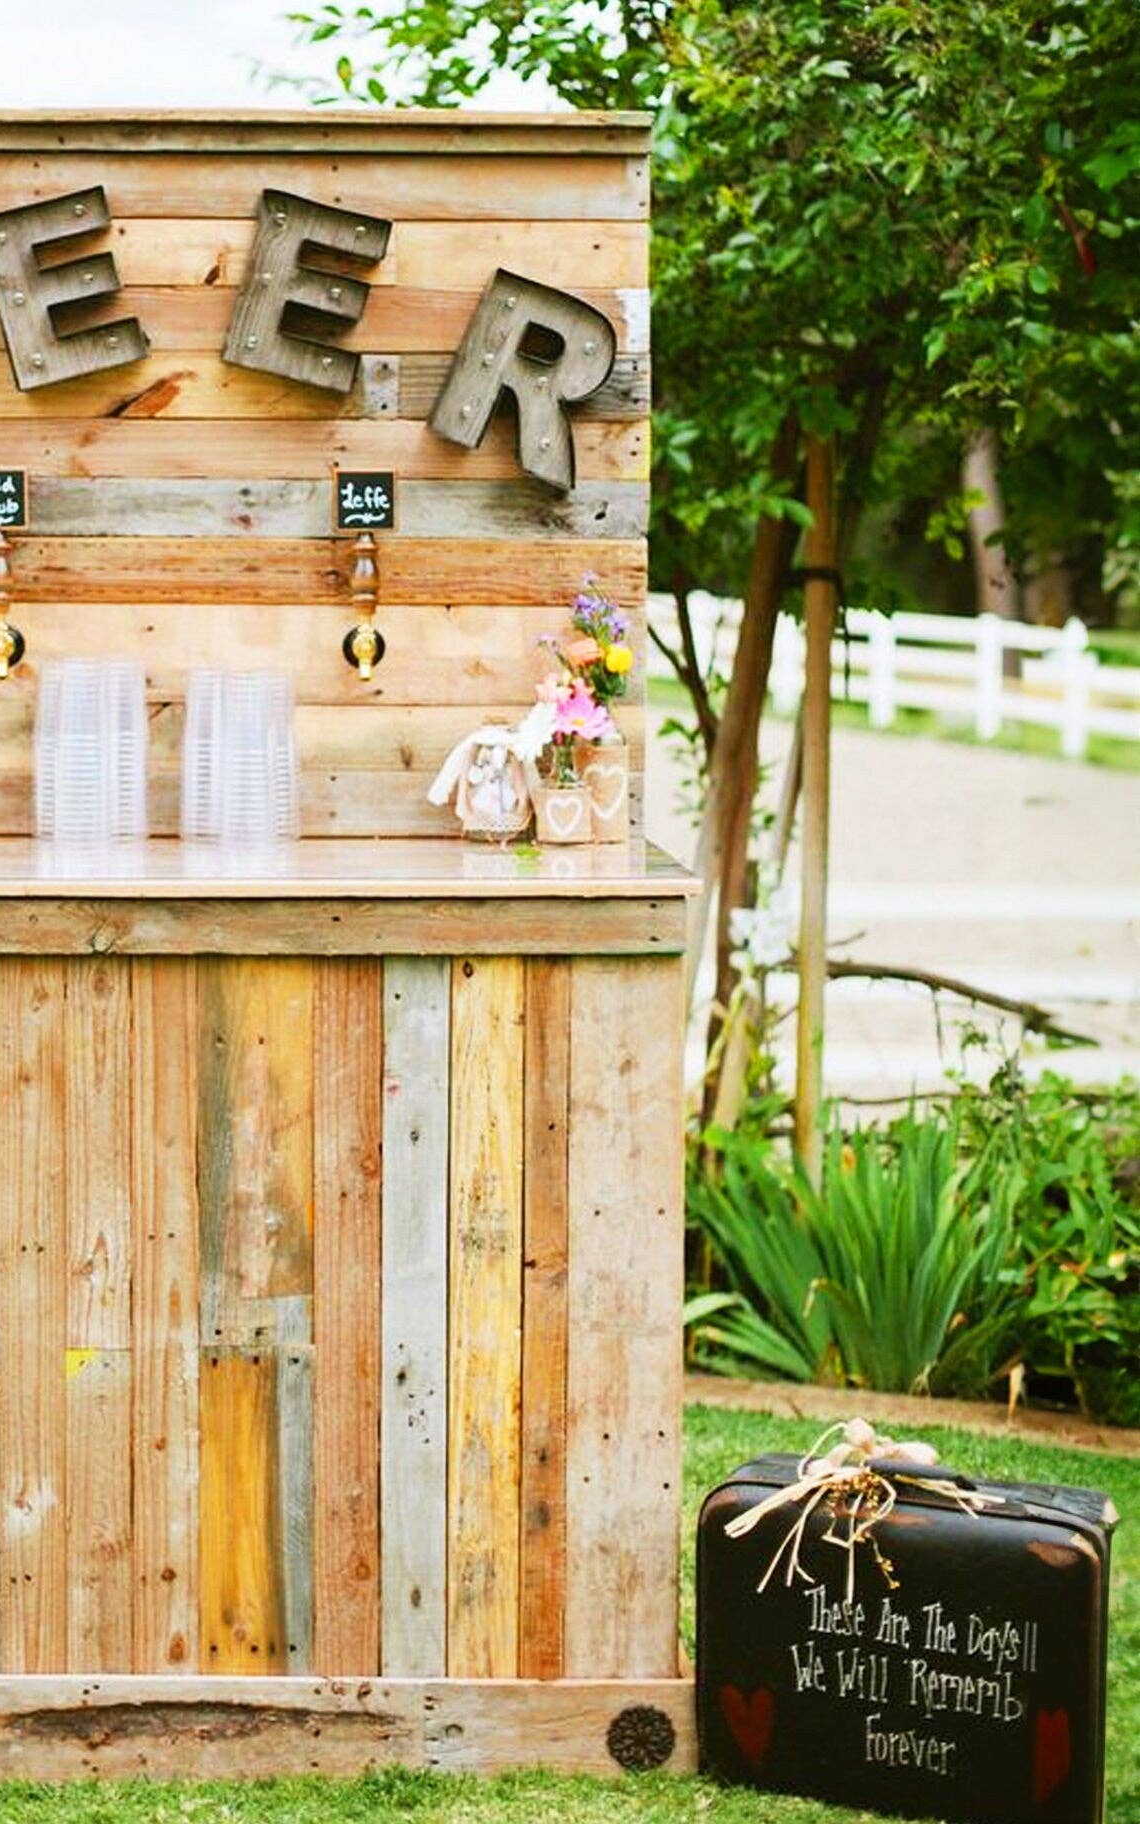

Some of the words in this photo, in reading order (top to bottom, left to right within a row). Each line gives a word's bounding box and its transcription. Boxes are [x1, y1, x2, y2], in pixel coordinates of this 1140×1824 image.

[804, 1584, 866, 1636] These
[876, 1597, 911, 1649] Are
[922, 1602, 957, 1655] The
[790, 1641, 827, 1692] We
[836, 1647, 889, 1703] Will
[866, 1712, 956, 1775] Forever
